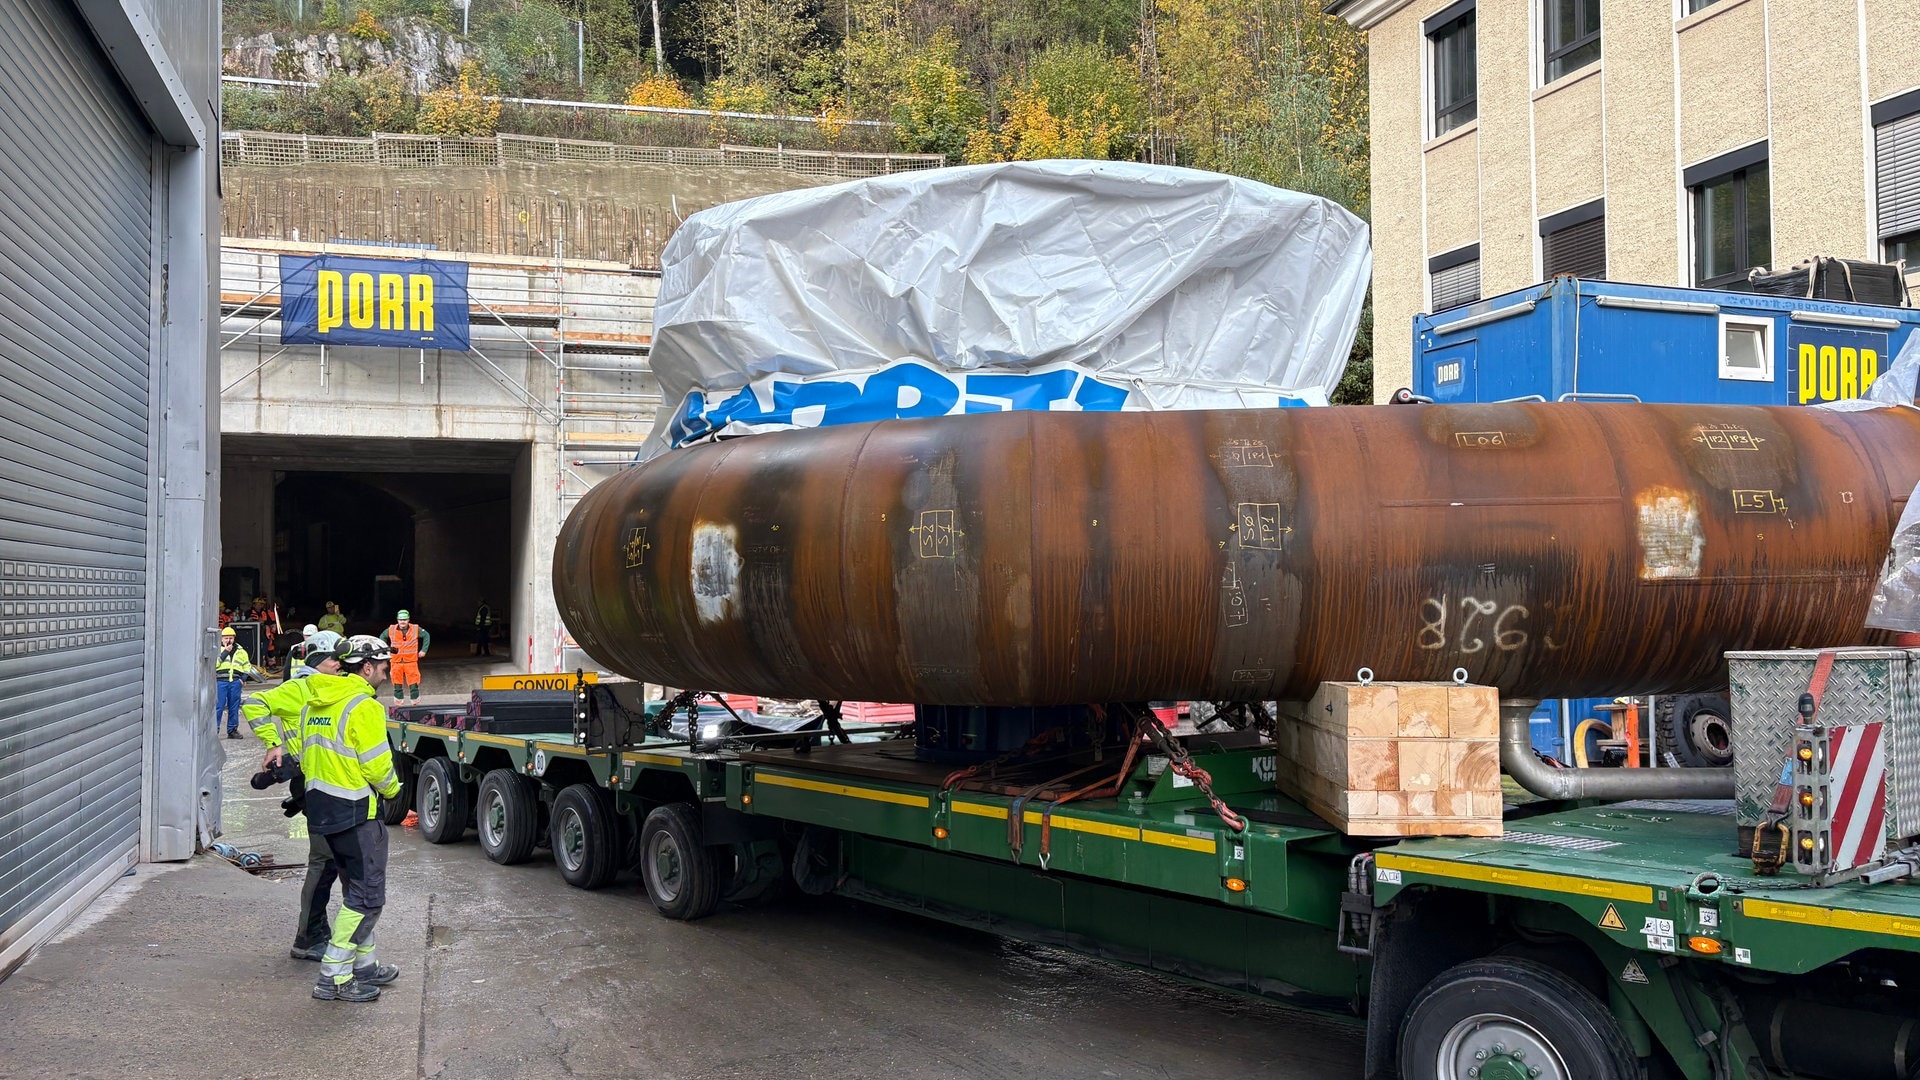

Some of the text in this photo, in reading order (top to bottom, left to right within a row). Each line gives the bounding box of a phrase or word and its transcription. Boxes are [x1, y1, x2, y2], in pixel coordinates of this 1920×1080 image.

[317, 269, 434, 333] PORR
[1437, 362, 1460, 385] PORR
[1739, 493, 1767, 509] L5
